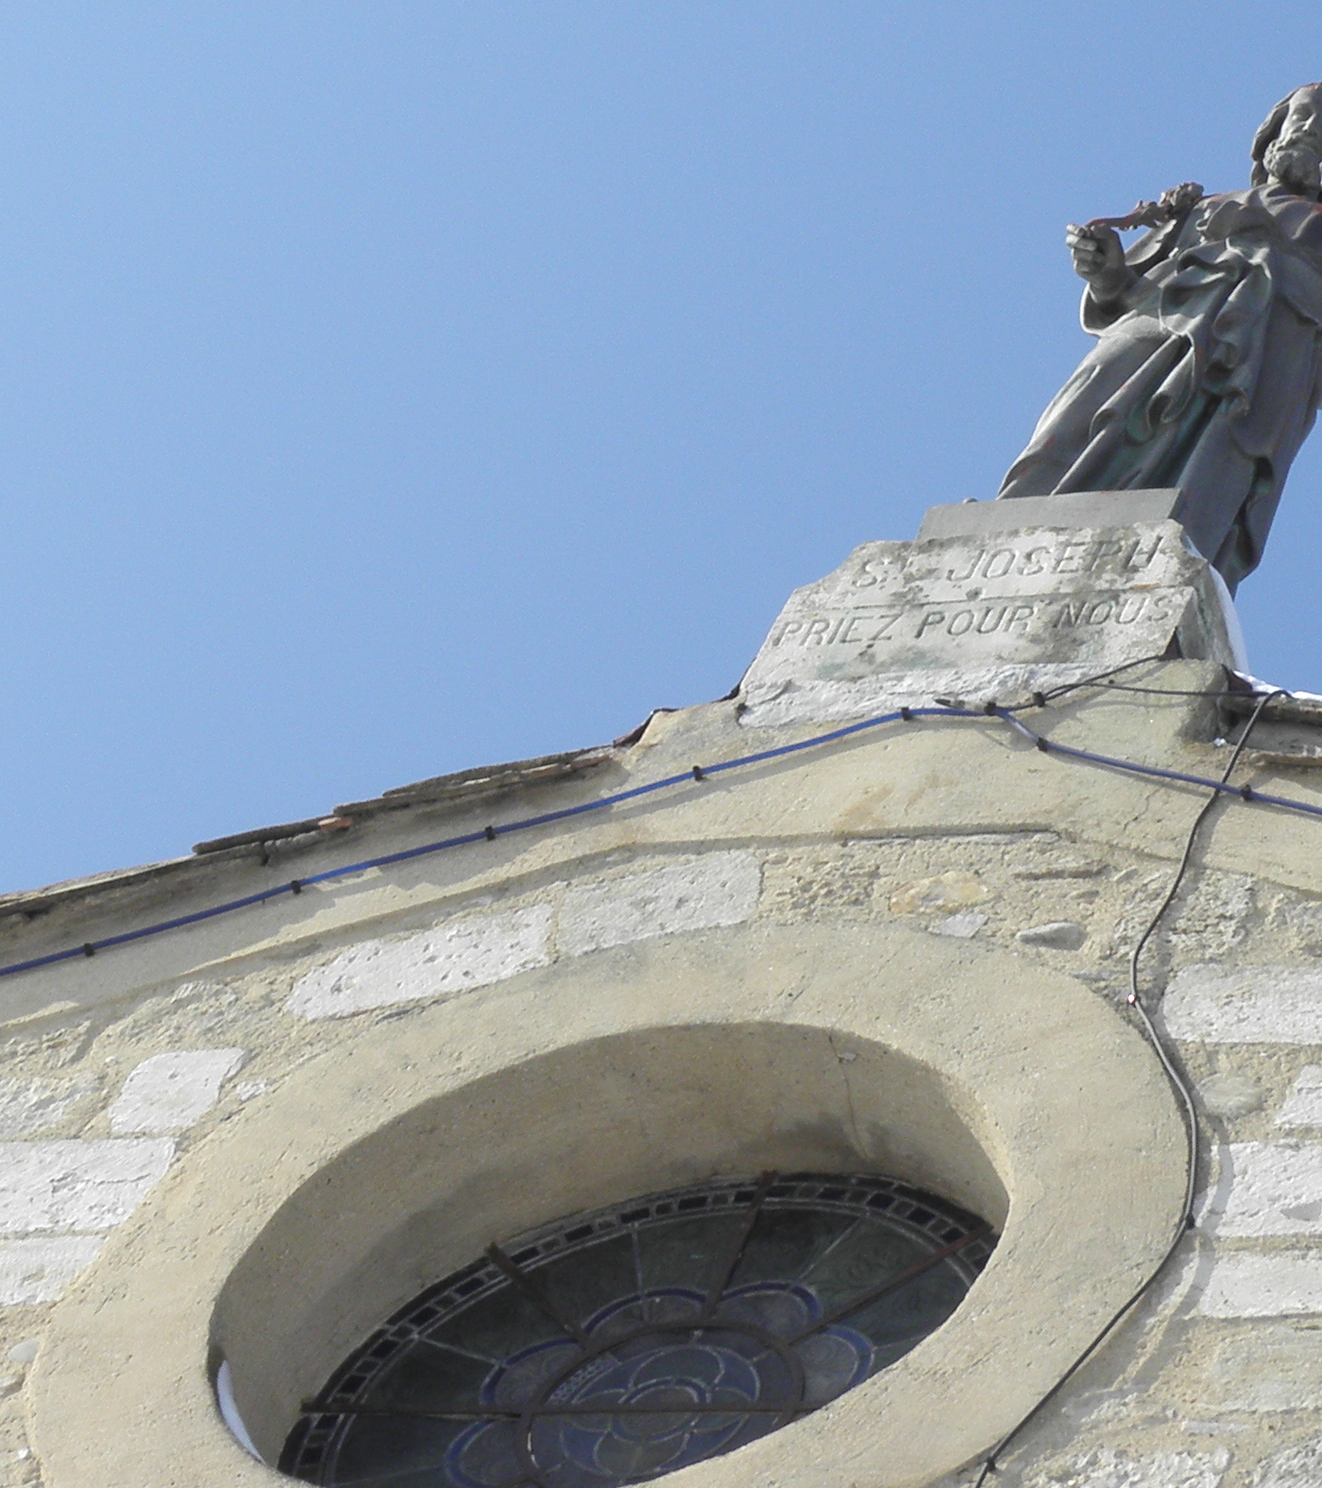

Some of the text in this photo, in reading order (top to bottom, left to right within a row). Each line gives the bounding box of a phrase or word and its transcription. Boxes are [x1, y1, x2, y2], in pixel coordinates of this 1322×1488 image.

[946, 534, 1164, 581] JOSEPH
[772, 596, 1174, 646] PRIEZ POUR NOUS
